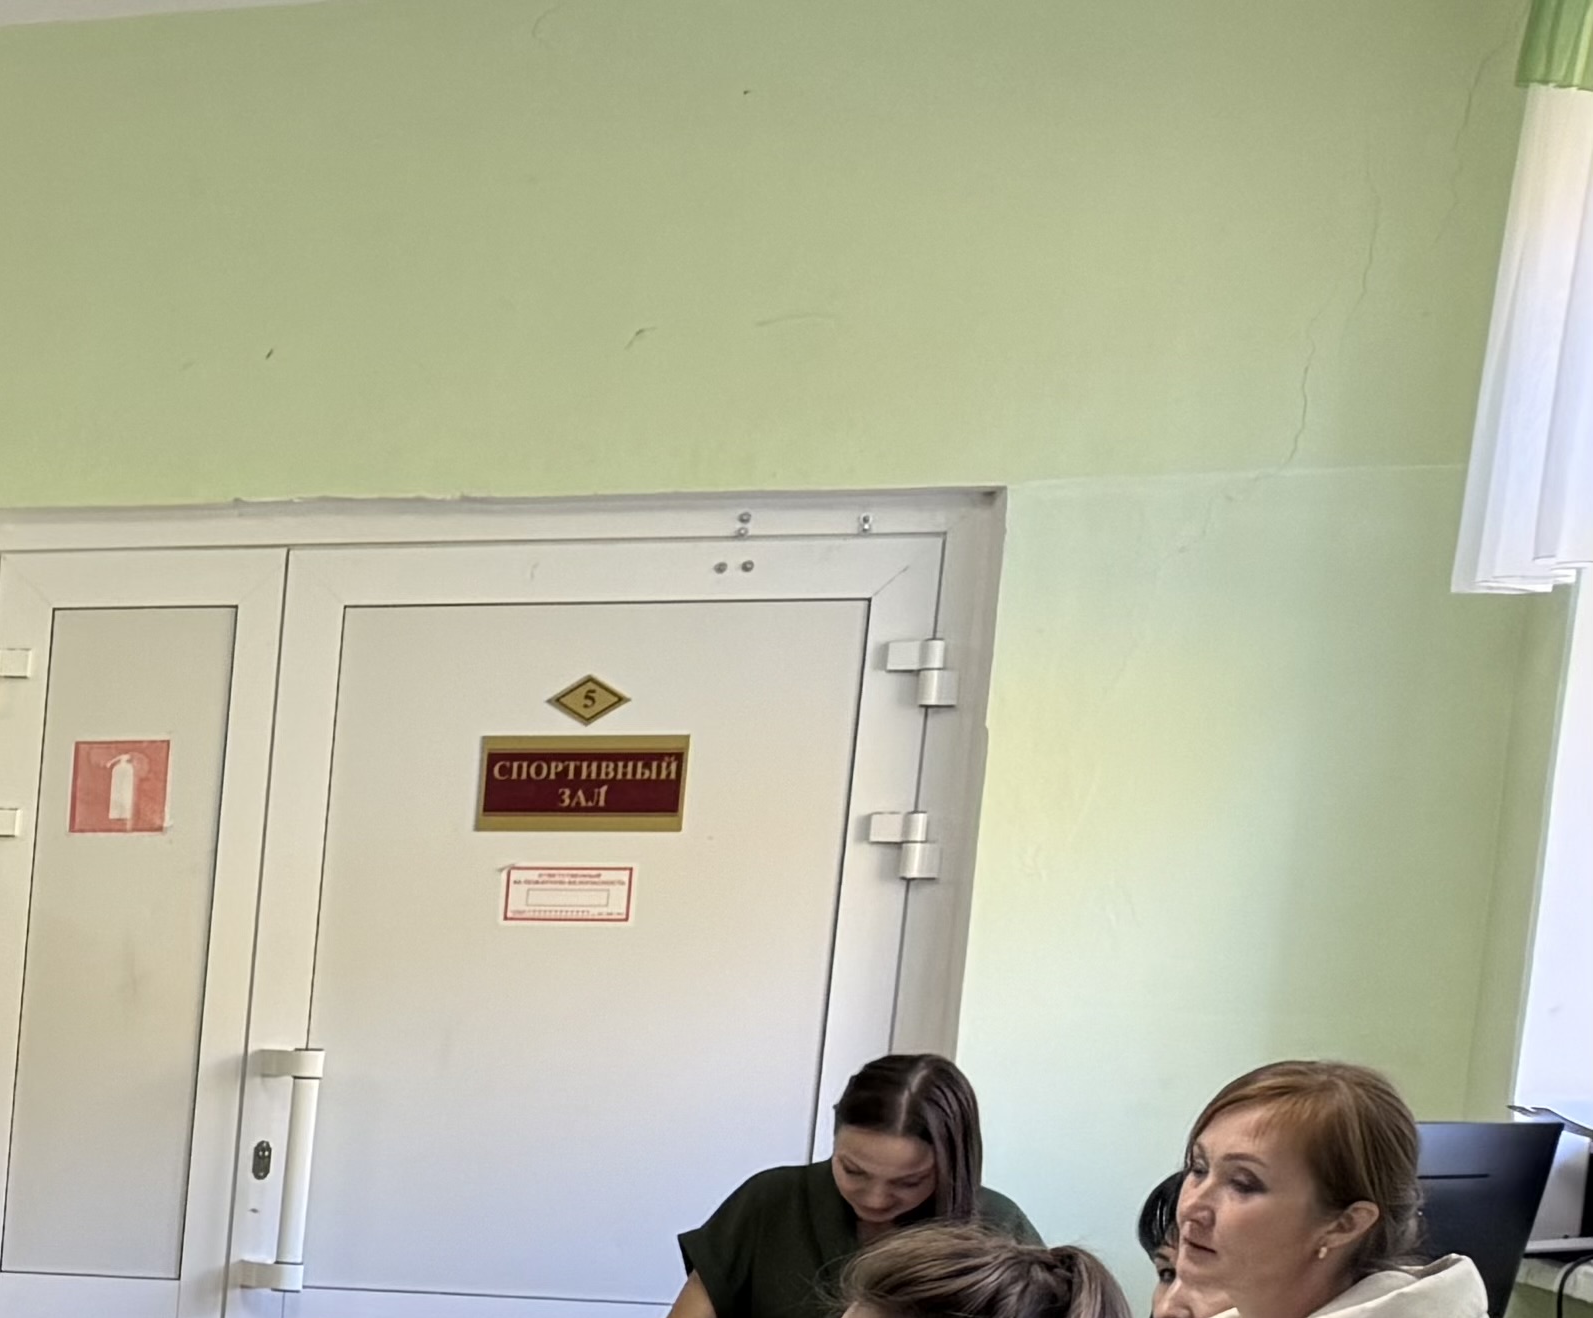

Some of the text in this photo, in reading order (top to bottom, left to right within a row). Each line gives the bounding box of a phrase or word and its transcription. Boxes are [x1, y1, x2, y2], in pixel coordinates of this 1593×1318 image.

[582, 688, 597, 709] 5
[492, 755, 680, 781] СПОРТИВНЫЙ
[558, 784, 609, 808] ЗАЛ
